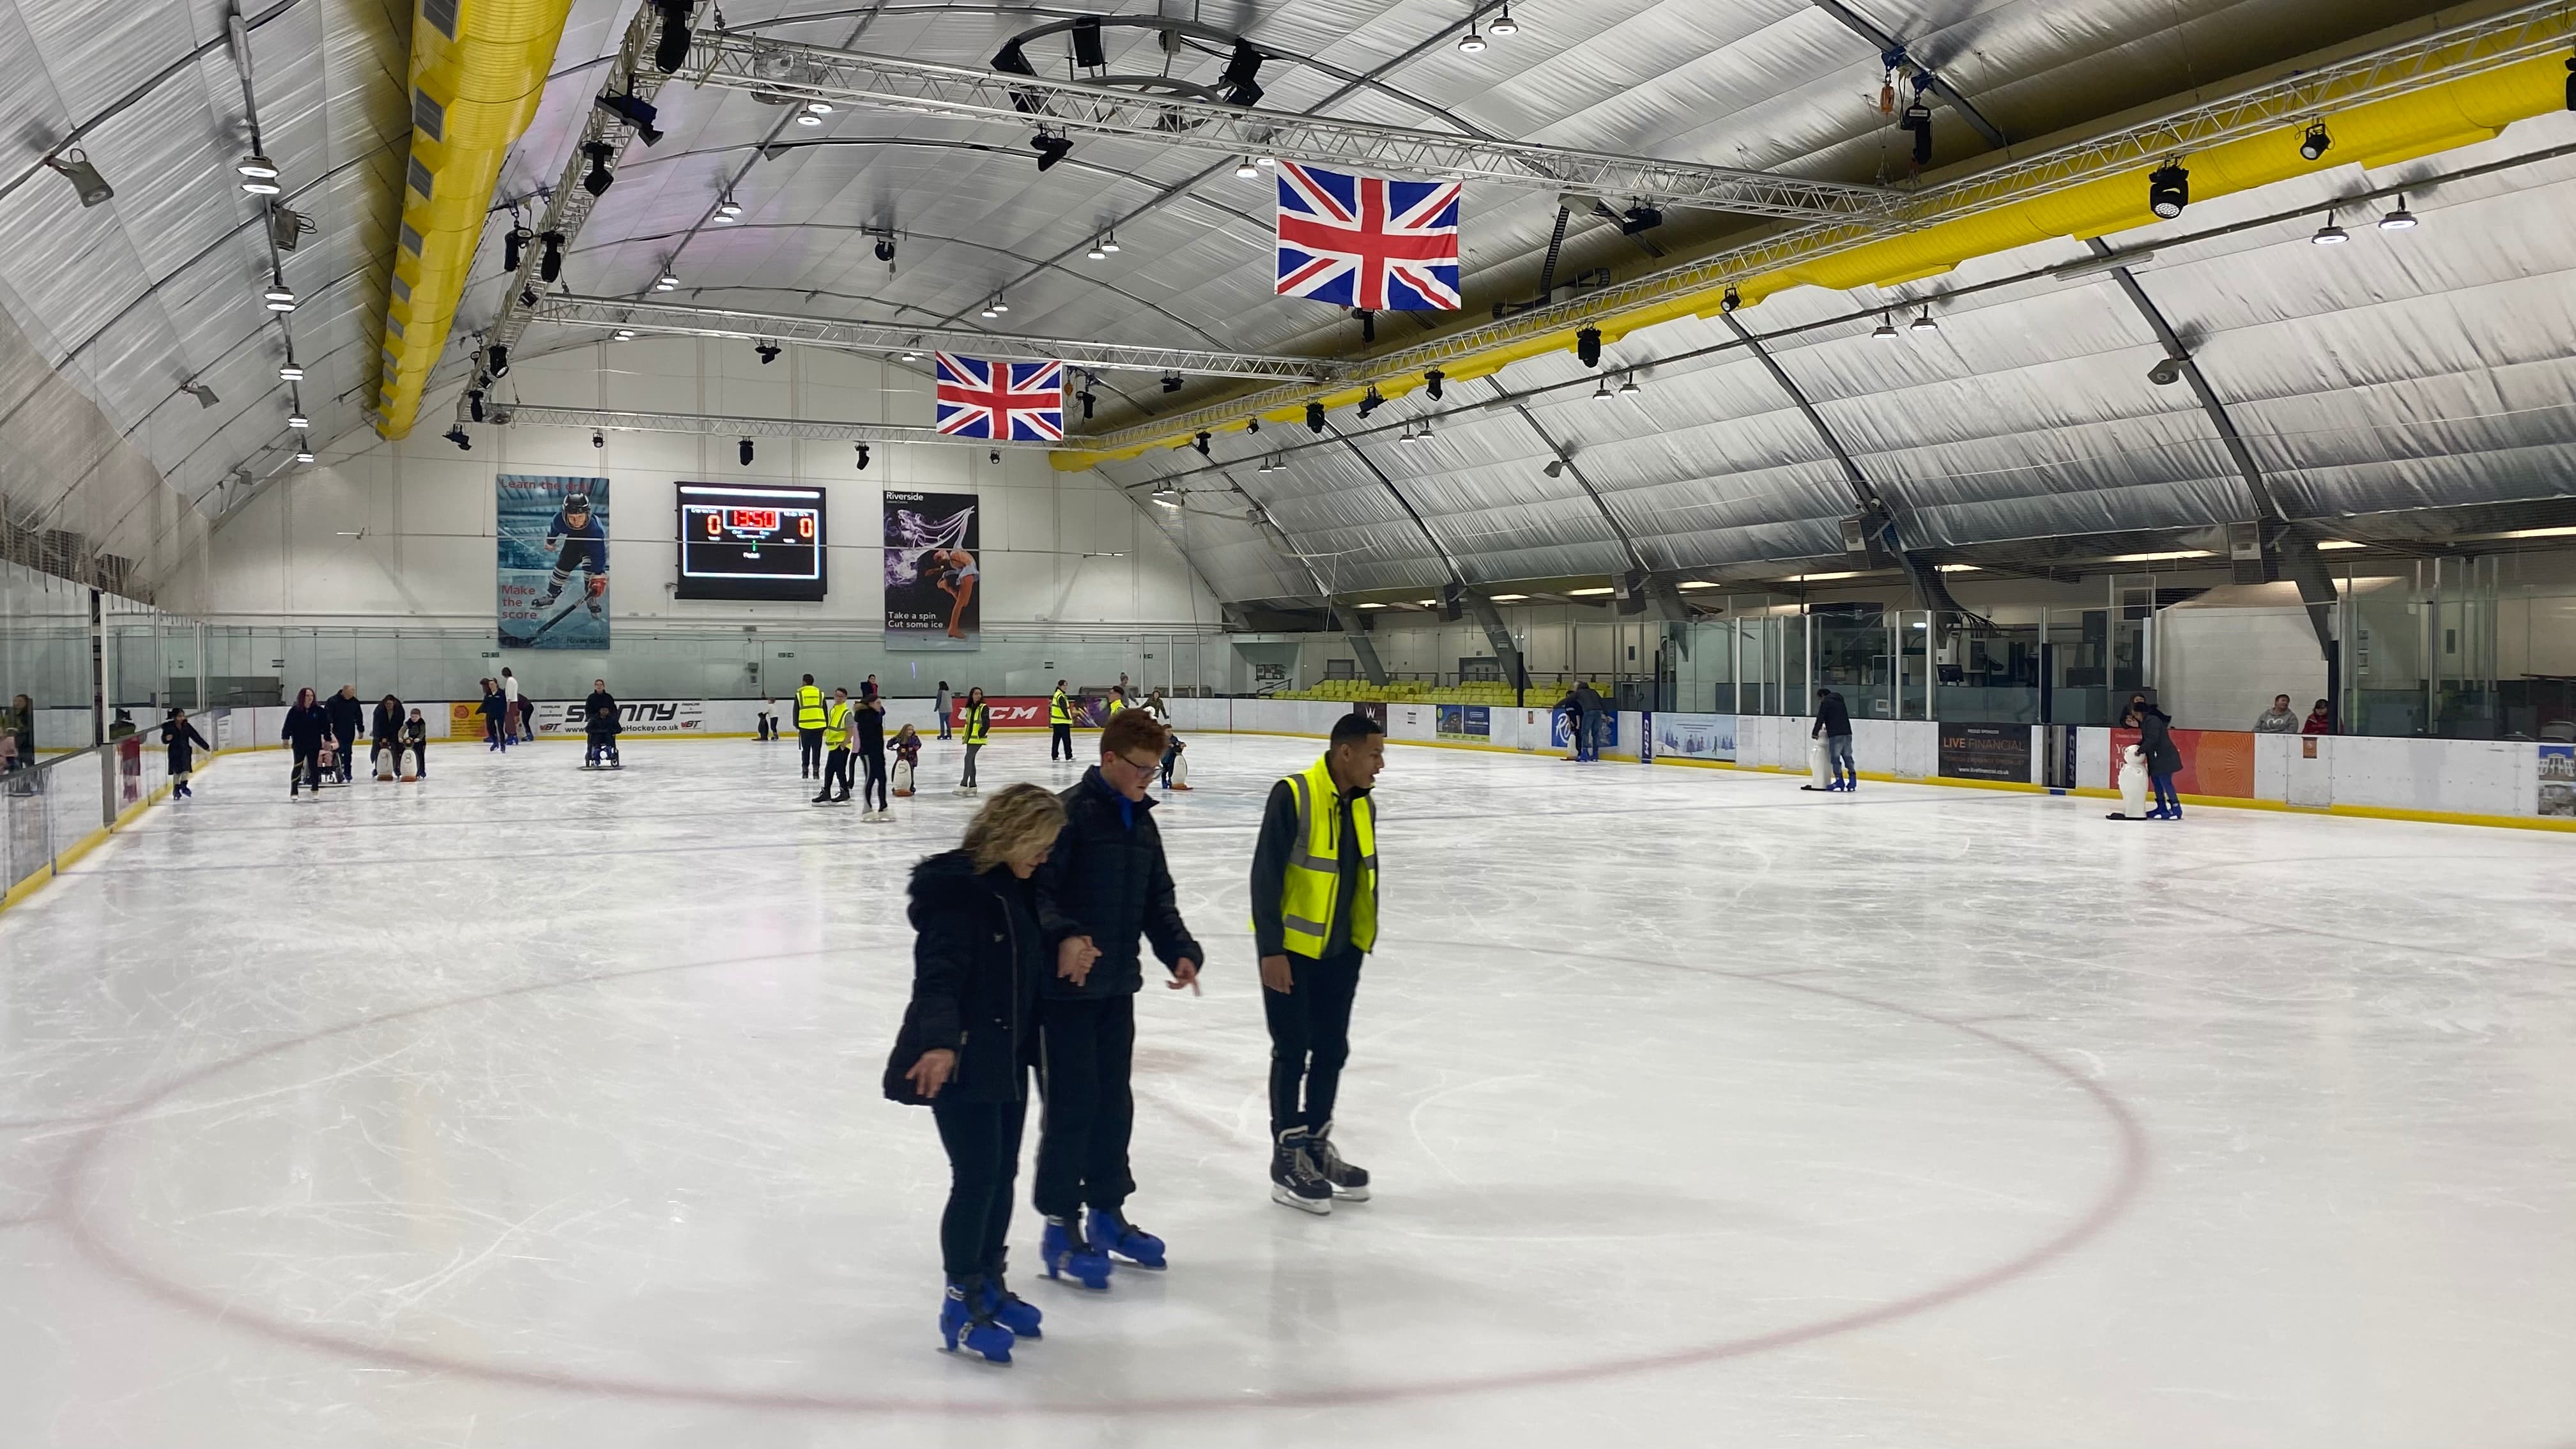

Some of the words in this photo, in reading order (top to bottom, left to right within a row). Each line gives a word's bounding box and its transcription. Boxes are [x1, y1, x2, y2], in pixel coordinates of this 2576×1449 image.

[501, 479, 536, 489] Learn
[541, 481, 560, 490] the
[886, 491, 924, 501] Riverside
[733, 510, 775, 528] 13:50
[707, 515, 721, 535] 0
[800, 518, 813, 537] 0
[502, 585, 535, 595] Make
[502, 597, 523, 607] the
[888, 620, 903, 628] Cut
[1943, 737, 1966, 748] LIVE
[1968, 739, 2025, 751] FINANCIAL
[404, 753, 411, 763] 8
[898, 763, 908, 774] 5
